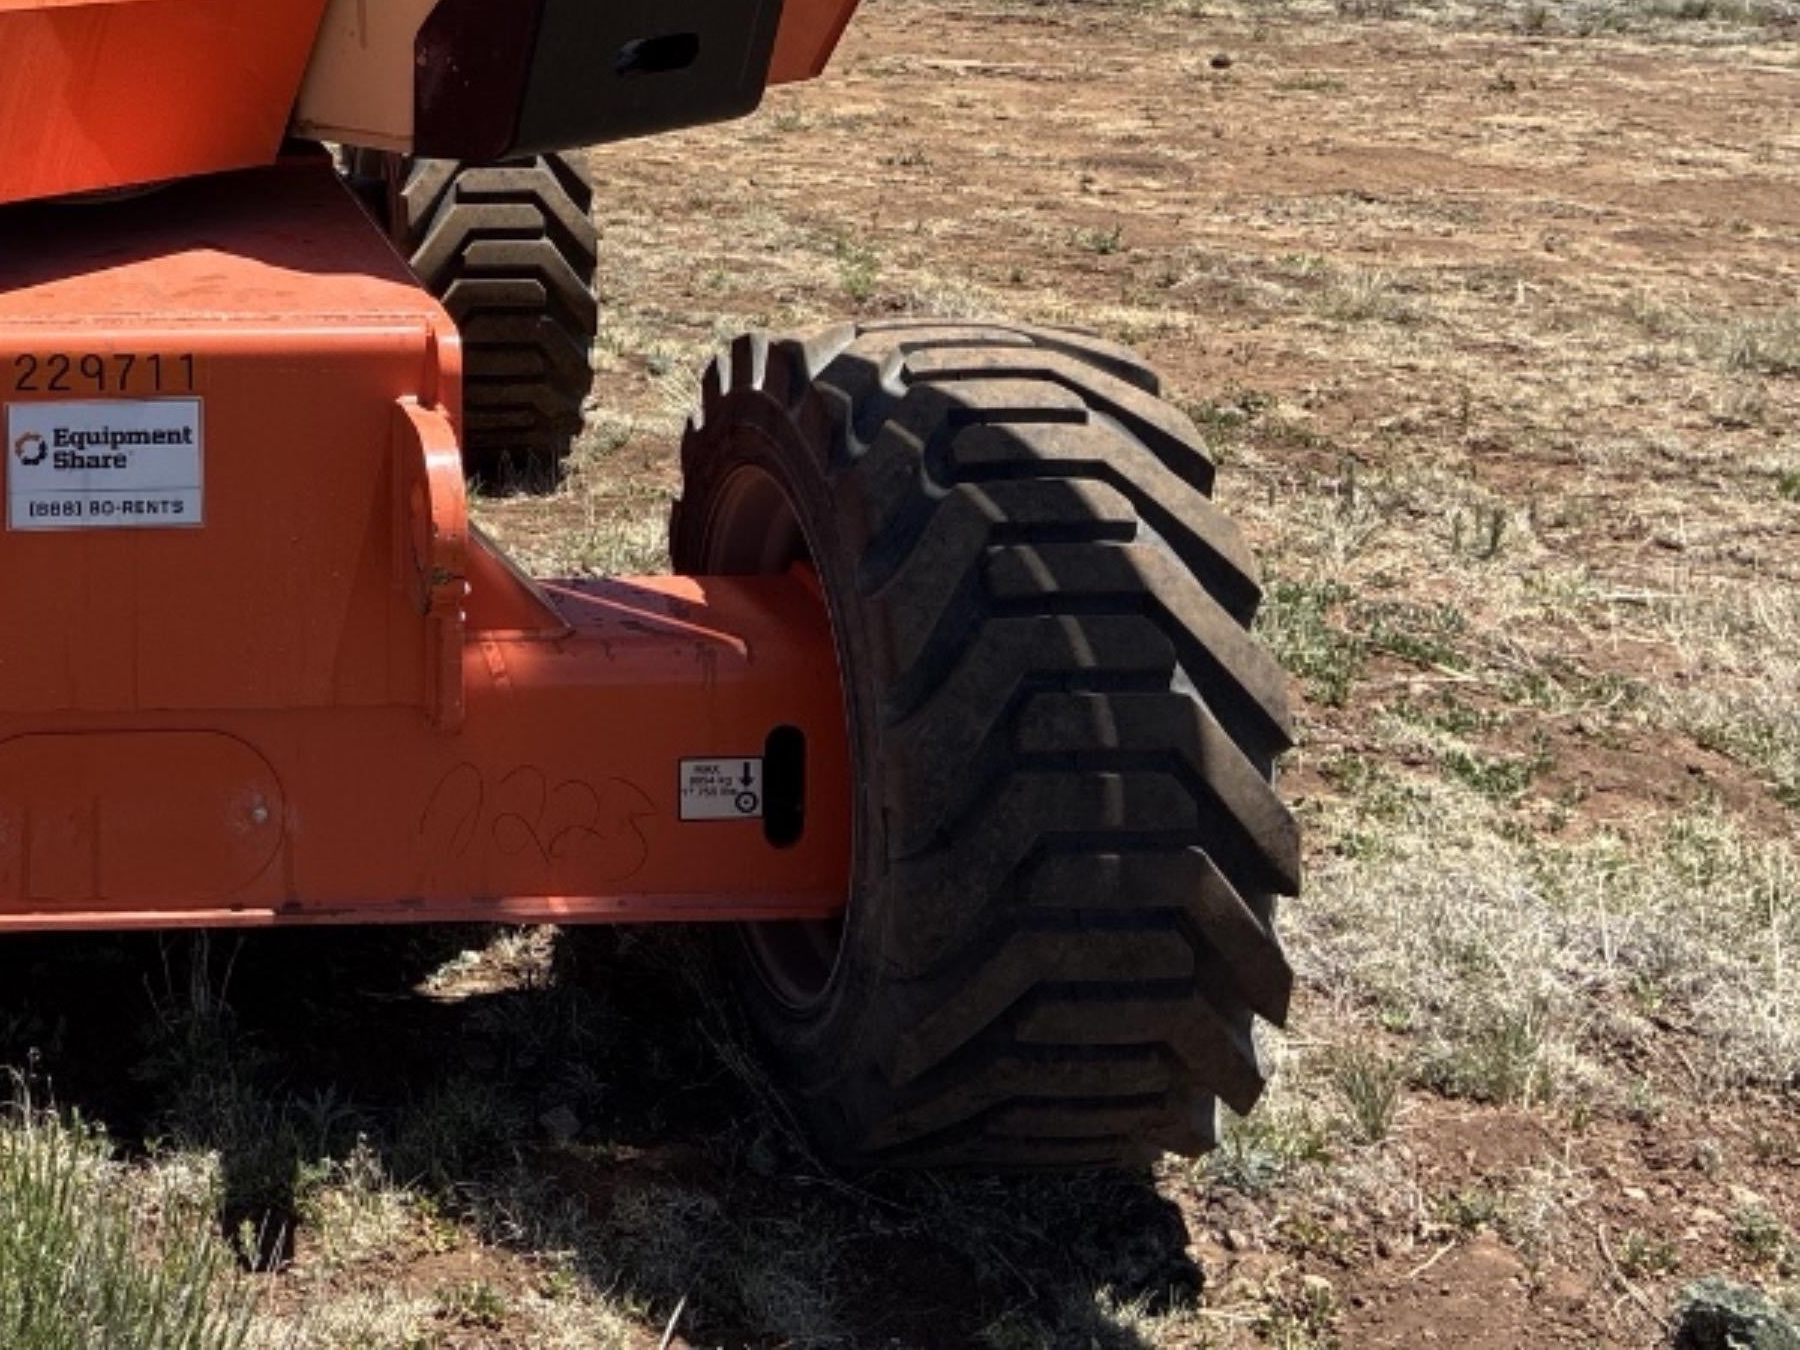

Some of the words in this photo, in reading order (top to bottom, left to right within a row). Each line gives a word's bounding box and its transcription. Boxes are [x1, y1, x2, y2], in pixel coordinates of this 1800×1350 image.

[14, 353, 194, 391] 229711
[53, 425, 193, 450] Equipment
[53, 451, 128, 469] Share
[89, 500, 185, 517] 80-RENTS
